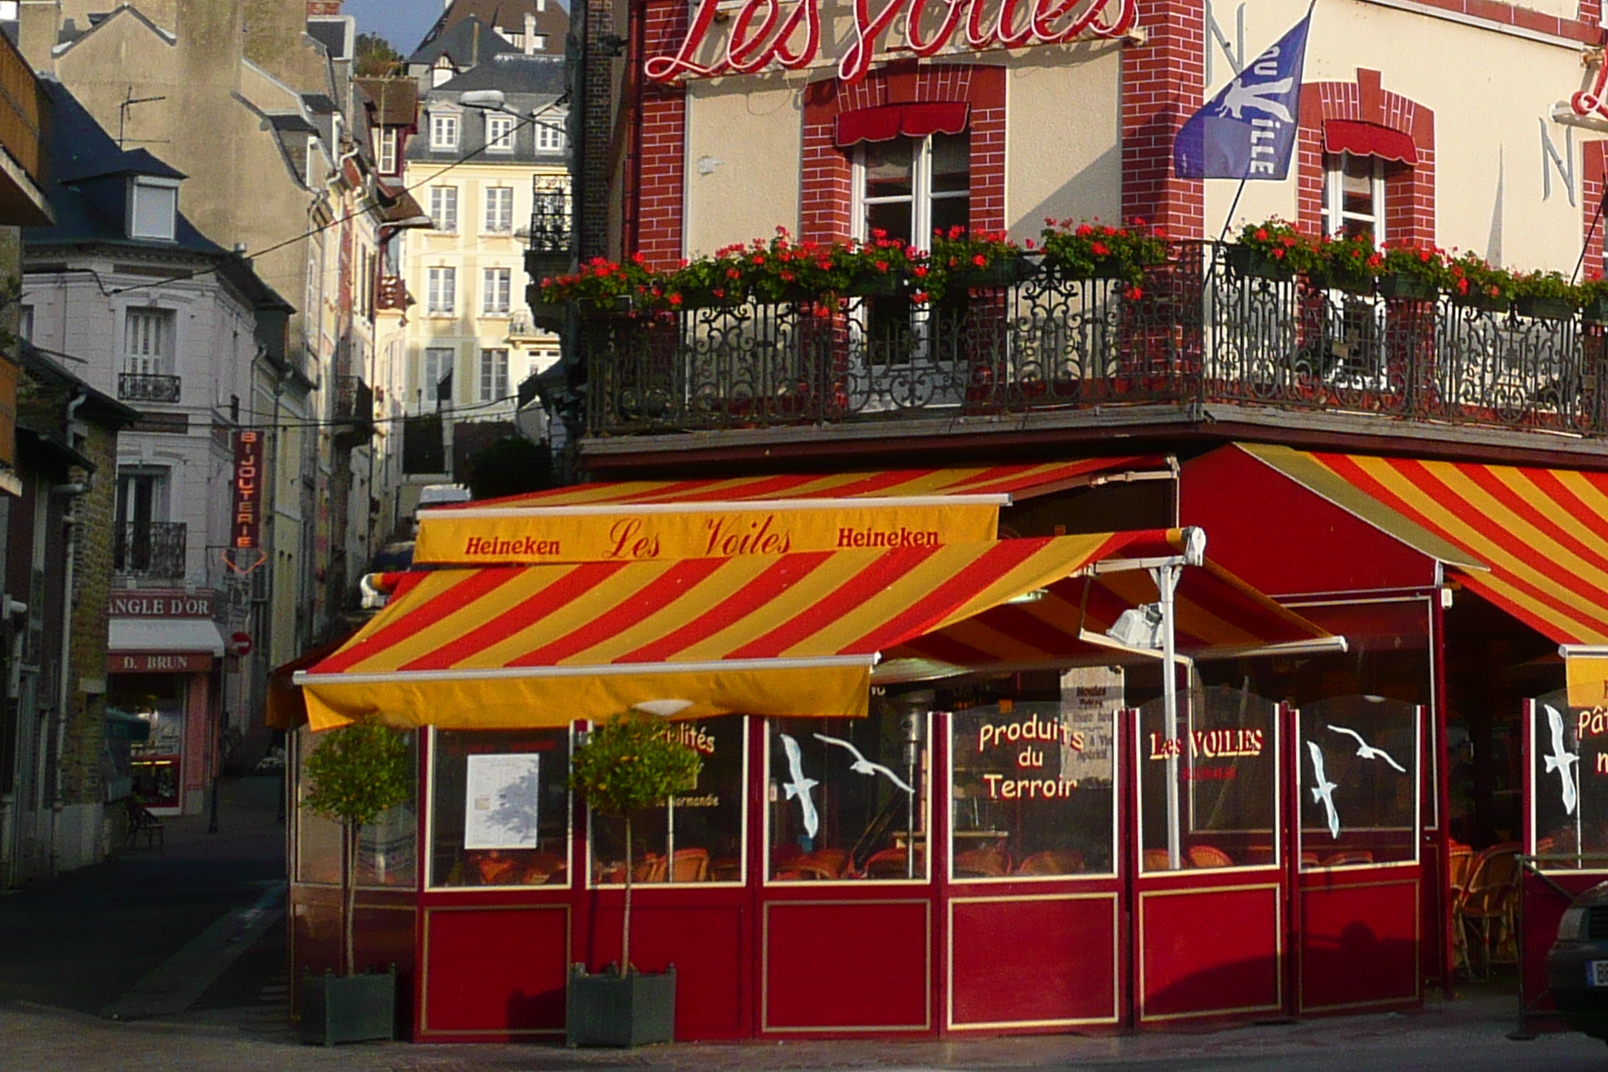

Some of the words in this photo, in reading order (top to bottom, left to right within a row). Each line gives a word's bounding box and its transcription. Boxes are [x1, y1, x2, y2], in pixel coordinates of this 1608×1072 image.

[238, 431, 257, 548] BIJOUTERIE
[465, 536, 561, 555] Heineken
[602, 517, 660, 558] Les
[704, 514, 791, 556] Voiles
[837, 527, 939, 548] Heineken
[171, 597, 209, 616] D'OR
[124, 657, 138, 670] D.
[147, 656, 188, 670] BRUN
[1189, 728, 1264, 759] VOILES
[1018, 745, 1044, 767] du
[984, 774, 1078, 798] Terroir
